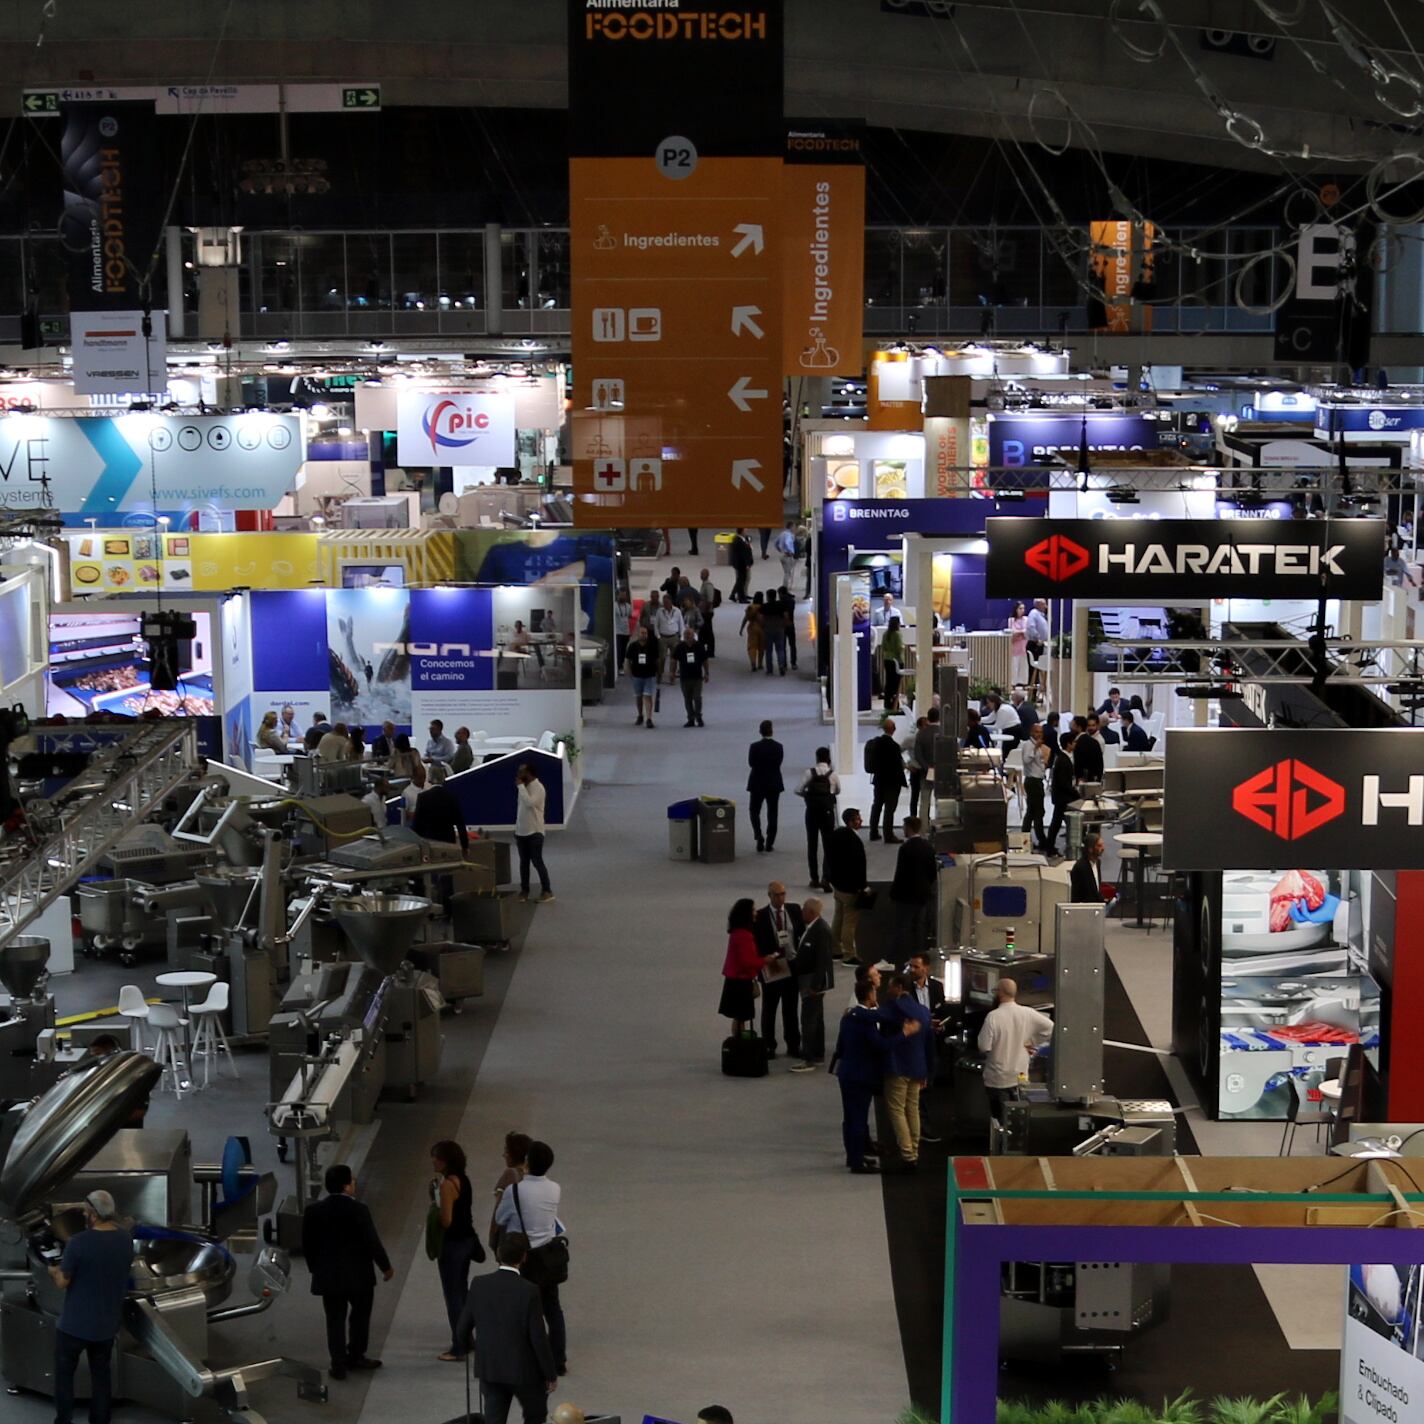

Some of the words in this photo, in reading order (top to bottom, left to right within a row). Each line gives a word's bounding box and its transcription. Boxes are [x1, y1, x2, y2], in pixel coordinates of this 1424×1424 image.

[586, 12, 766, 40] FOODTECH
[787, 138, 861, 151] FOODTECH
[662, 149, 691, 168] P2
[101, 150, 126, 293] FOODTECH
[623, 232, 720, 249] Ingredientes
[809, 181, 832, 321] Ingredientes
[449, 407, 490, 434] pic
[148, 484, 266, 501] www.sivefs.com
[849, 508, 910, 519] BRENNTAG
[1219, 508, 1281, 520] BRENNTAG
[1097, 543, 1347, 577] HARATEK
[419, 659, 475, 669] Conocemos
[419, 672, 428, 682] el
[430, 673, 465, 682] camino
[1358, 1358, 1409, 1406] Embuchado
[1365, 1388, 1399, 1424] Clipado
